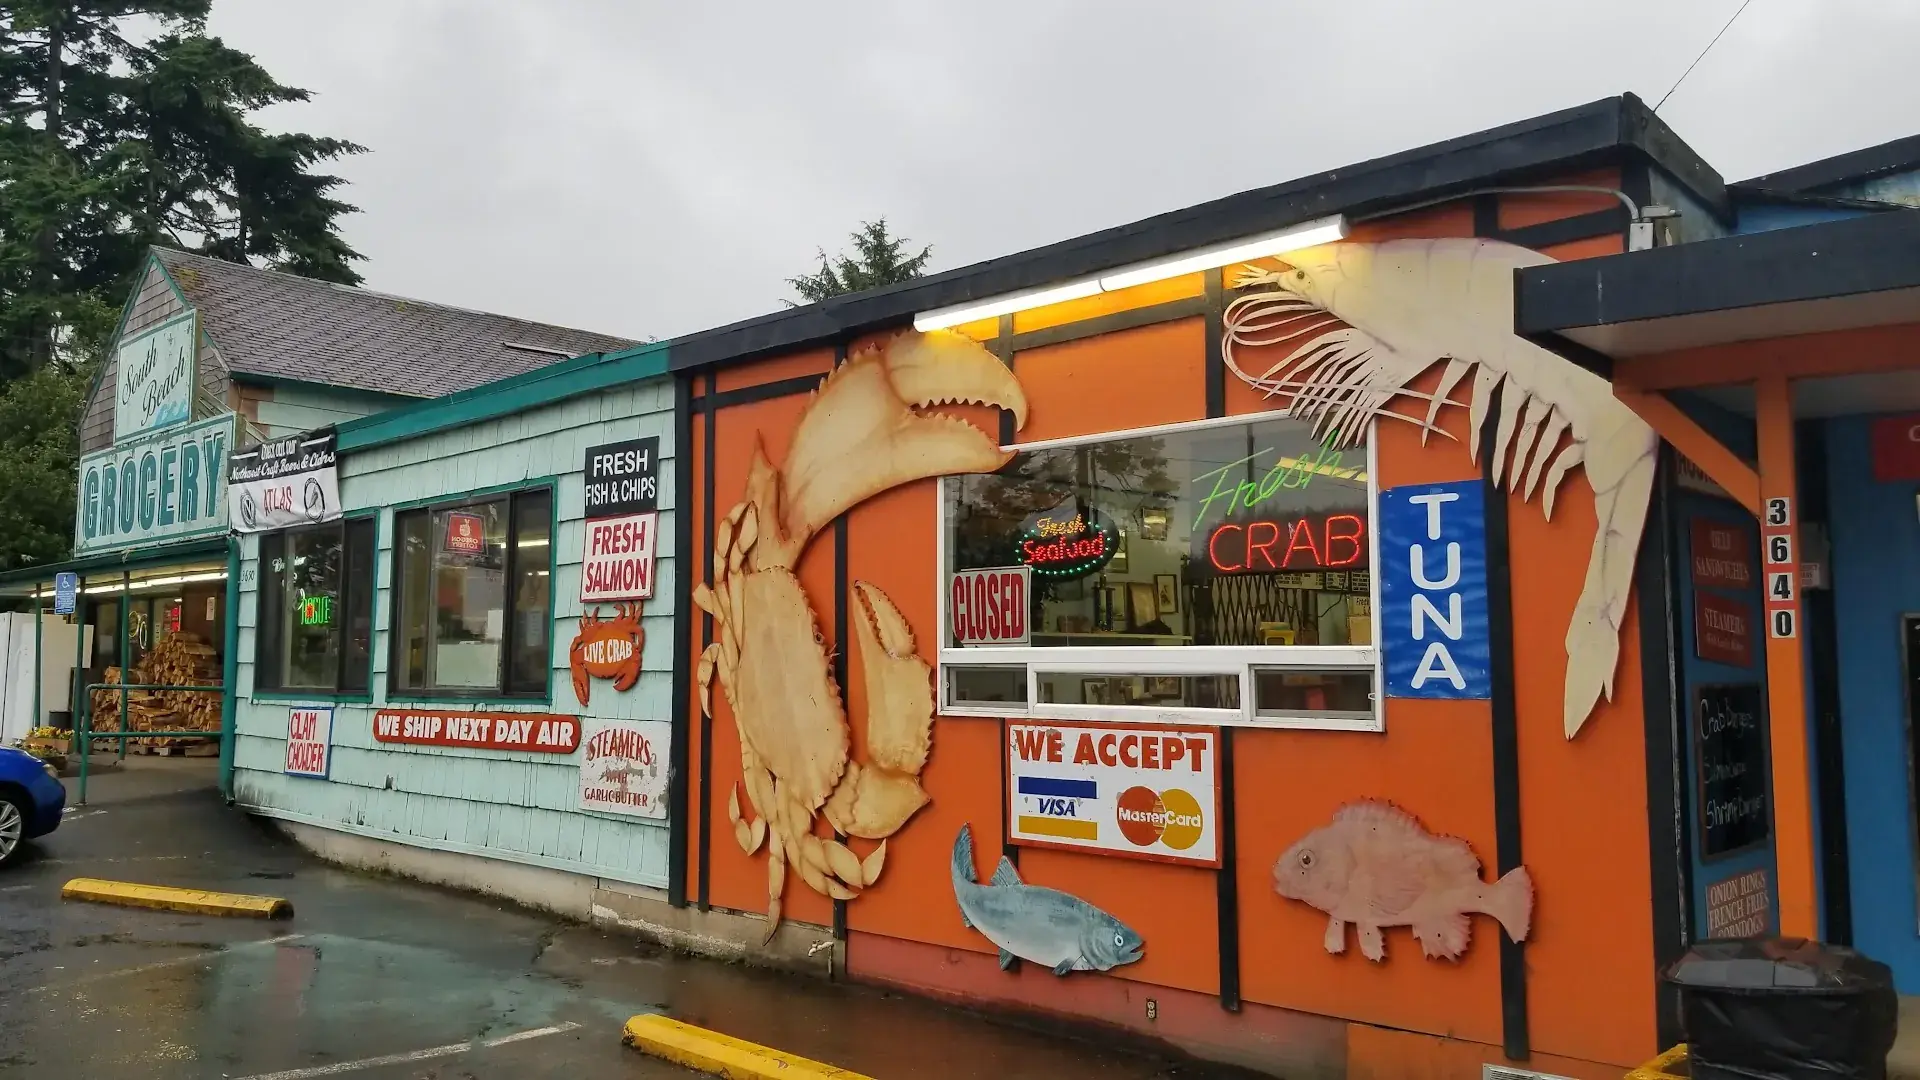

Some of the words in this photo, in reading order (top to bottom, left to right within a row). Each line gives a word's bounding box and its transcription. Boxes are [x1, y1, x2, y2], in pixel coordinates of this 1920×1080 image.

[122, 337, 159, 406] South
[141, 346, 185, 427] Beach
[261, 462, 279, 478] Craft
[279, 458, 300, 474] Beers
[301, 454, 309, 469] &
[593, 448, 648, 478] FRESH
[1192, 428, 1364, 532] Fresh
[84, 431, 223, 541] GROCERY
[263, 485, 292, 517] ATLAS
[585, 482, 608, 507] FISH
[610, 481, 619, 503] &
[621, 476, 655, 502] CHIPS
[592, 521, 646, 556] FRESH
[1036, 513, 1086, 538] Fresh
[1023, 531, 1104, 564] Seafood
[1209, 515, 1363, 571] CRAB
[585, 558, 648, 593] SALMON
[1768, 499, 1792, 636] 3640
[952, 573, 1024, 641] CLOSED
[1408, 492, 1467, 690] TUNA
[1704, 607, 1746, 634] STEAMERS
[584, 640, 604, 663] LIVE
[607, 638, 632, 663] CRAB
[290, 712, 317, 740] CLAM
[378, 714, 400, 736] WE
[403, 715, 442, 739] SHIP
[445, 717, 490, 742] NEXT
[494, 719, 534, 744] DAY
[535, 720, 574, 747] AIR
[287, 742, 325, 772] CHOWDER
[587, 728, 651, 766] STEAMERS
[1015, 729, 1063, 763] WE
[1073, 733, 1207, 772] ACCEPT
[584, 787, 613, 803] GARLIC
[615, 790, 648, 807] BUTTER
[1038, 797, 1076, 817] VISA
[1118, 807, 1201, 828] MasterCard
[1710, 880, 1738, 906] ONION
[1740, 871, 1766, 896] RINGS
[1709, 899, 1744, 931] FRENCH
[1746, 890, 1769, 916] FRIES
